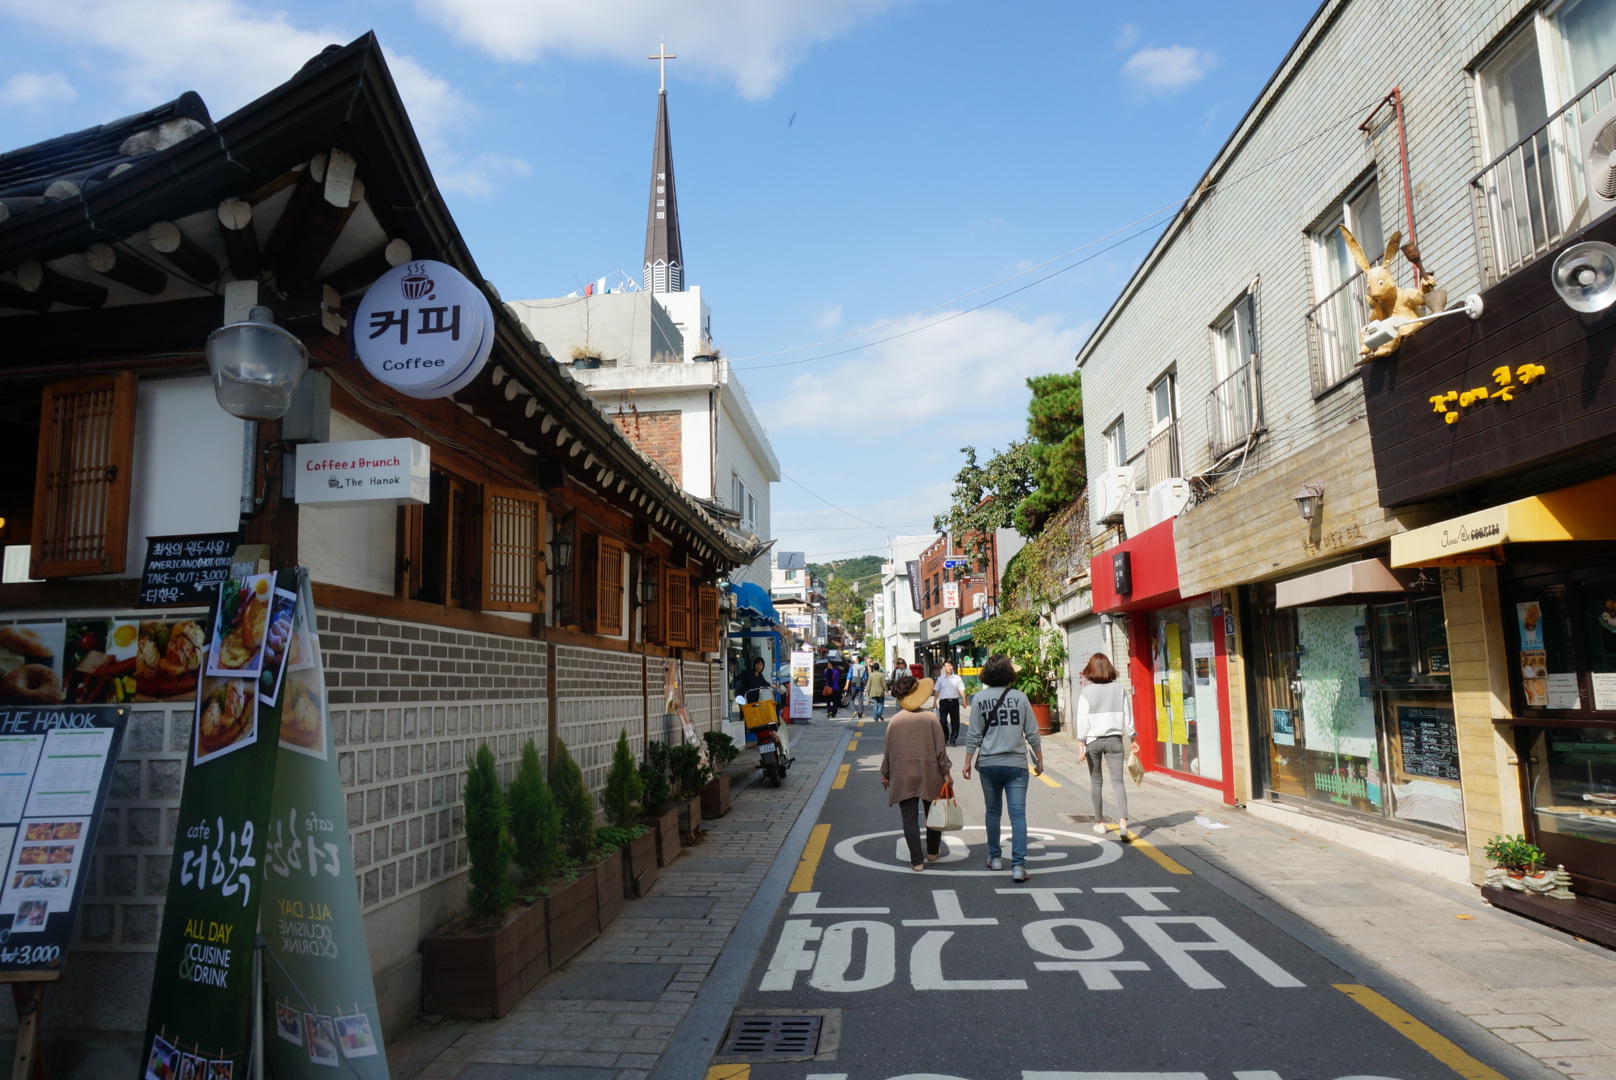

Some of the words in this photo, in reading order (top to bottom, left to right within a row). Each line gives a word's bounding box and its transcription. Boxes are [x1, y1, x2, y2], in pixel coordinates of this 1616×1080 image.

[369, 305, 461, 345] 커피
[383, 358, 445, 371] Coffee
[306, 459, 348, 471] Coffee
[358, 456, 400, 468] Brunch
[345, 478, 363, 487] The
[370, 476, 400, 485] Hanok
[152, 542, 182, 556] 최상의
[184, 540, 229, 556] 원두사용!
[0, 711, 32, 732] THE
[33, 711, 97, 731] HANOK
[187, 819, 210, 839] cafe
[181, 816, 256, 907] 더한옥
[184, 918, 205, 940] ALL
[208, 921, 233, 944] DAY
[190, 943, 231, 968] CUISINE
[193, 964, 228, 988] DRINK
